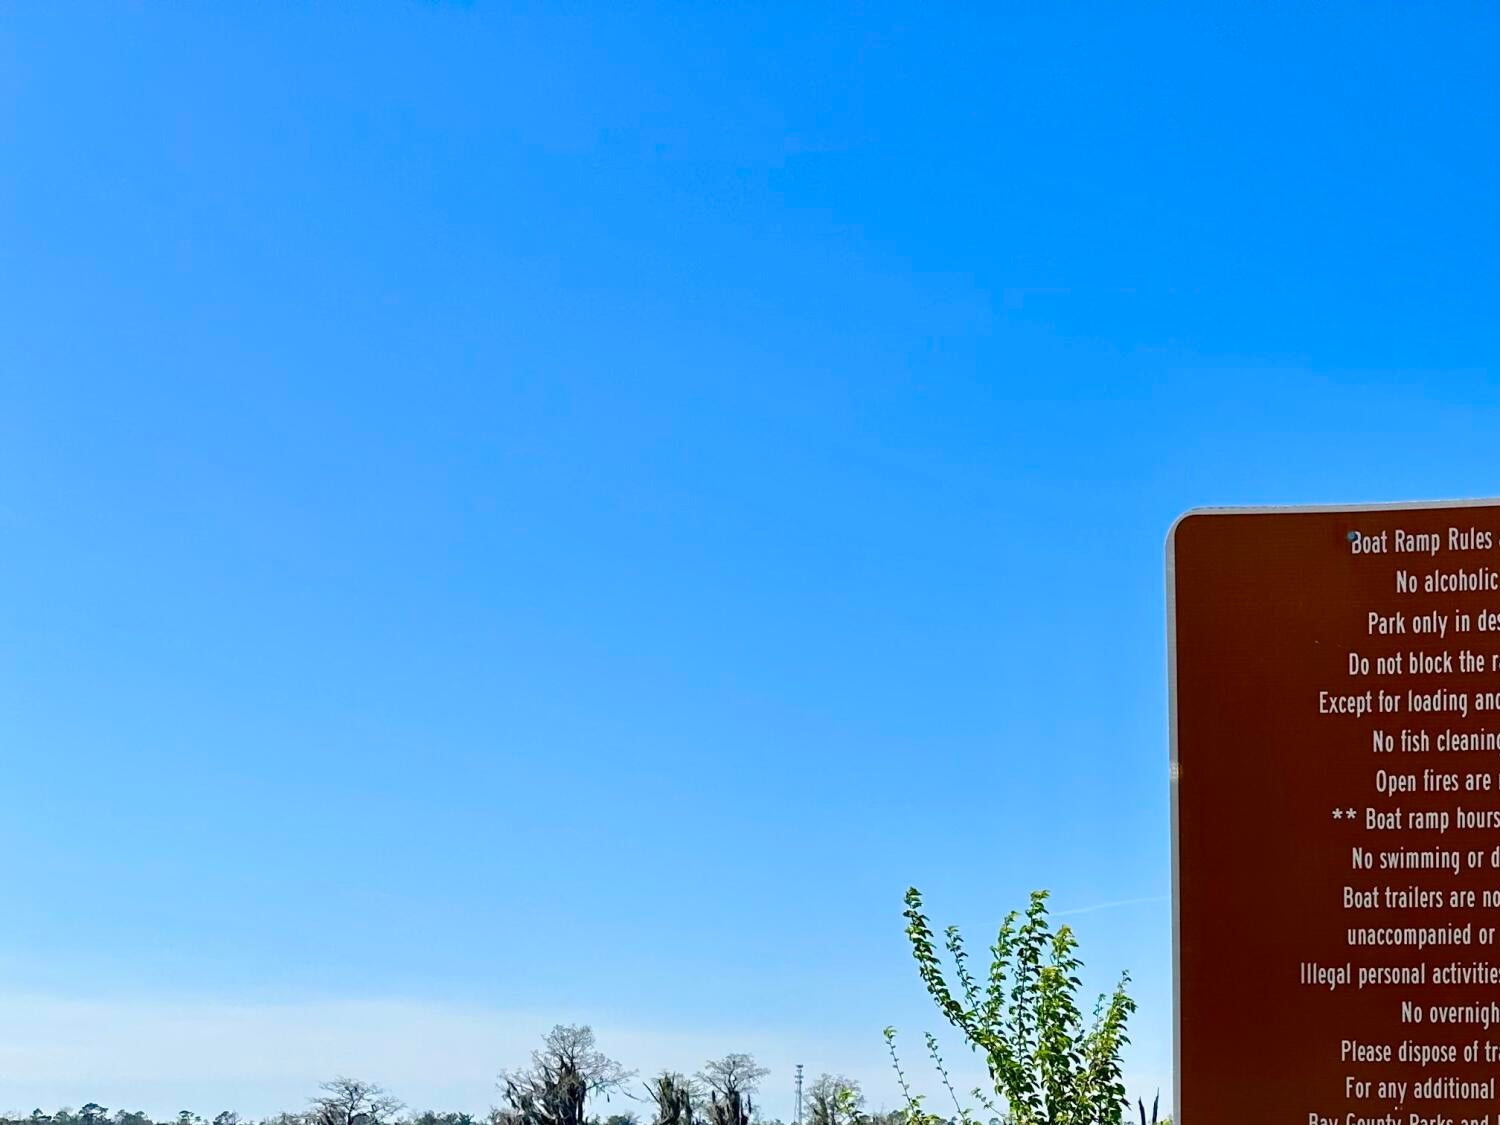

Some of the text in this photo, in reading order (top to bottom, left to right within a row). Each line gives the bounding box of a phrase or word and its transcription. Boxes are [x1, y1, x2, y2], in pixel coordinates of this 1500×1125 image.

[1351, 530, 1387, 554] Boat
[1396, 530, 1440, 556] Ramp
[1449, 527, 1492, 550] Rules
[1397, 571, 1417, 592] No
[1425, 568, 1498, 592] alcoholic
[1369, 612, 1405, 634] Park
[1413, 611, 1447, 638] only
[1456, 610, 1469, 632] in
[1350, 653, 1369, 675] Do
[1378, 652, 1402, 674] not
[1410, 651, 1452, 673] block
[1459, 650, 1484, 672] the
[1320, 691, 1372, 717] Except
[1379, 690, 1400, 712] for
[1409, 689, 1467, 717] loading
[1374, 731, 1393, 752] No
[1401, 730, 1429, 751] fish
[1377, 770, 1416, 796] Open
[1424, 769, 1458, 791] fires
[1466, 774, 1491, 790] are
[1367, 808, 1401, 829] Boat
[1409, 812, 1448, 833] ramp
[1353, 848, 1372, 869] No
[1380, 846, 1459, 875] swimming
[1468, 852, 1484, 868] or
[1344, 887, 1379, 908] Boat
[1385, 886, 1443, 908] trailers
[1450, 891, 1475, 907] are
[1348, 923, 1470, 949] unaccompanied
[1479, 928, 1495, 944] or
[1301, 963, 1350, 990] Illegal
[1359, 963, 1424, 988] personal
[1402, 1002, 1422, 1023] No
[1342, 1040, 1391, 1061] Please
[1399, 1040, 1456, 1066] dispose
[1464, 1040, 1478, 1062] of
[1347, 1077, 1371, 1098] For
[1378, 1082, 1407, 1103] any
[1414, 1077, 1494, 1099] additional
